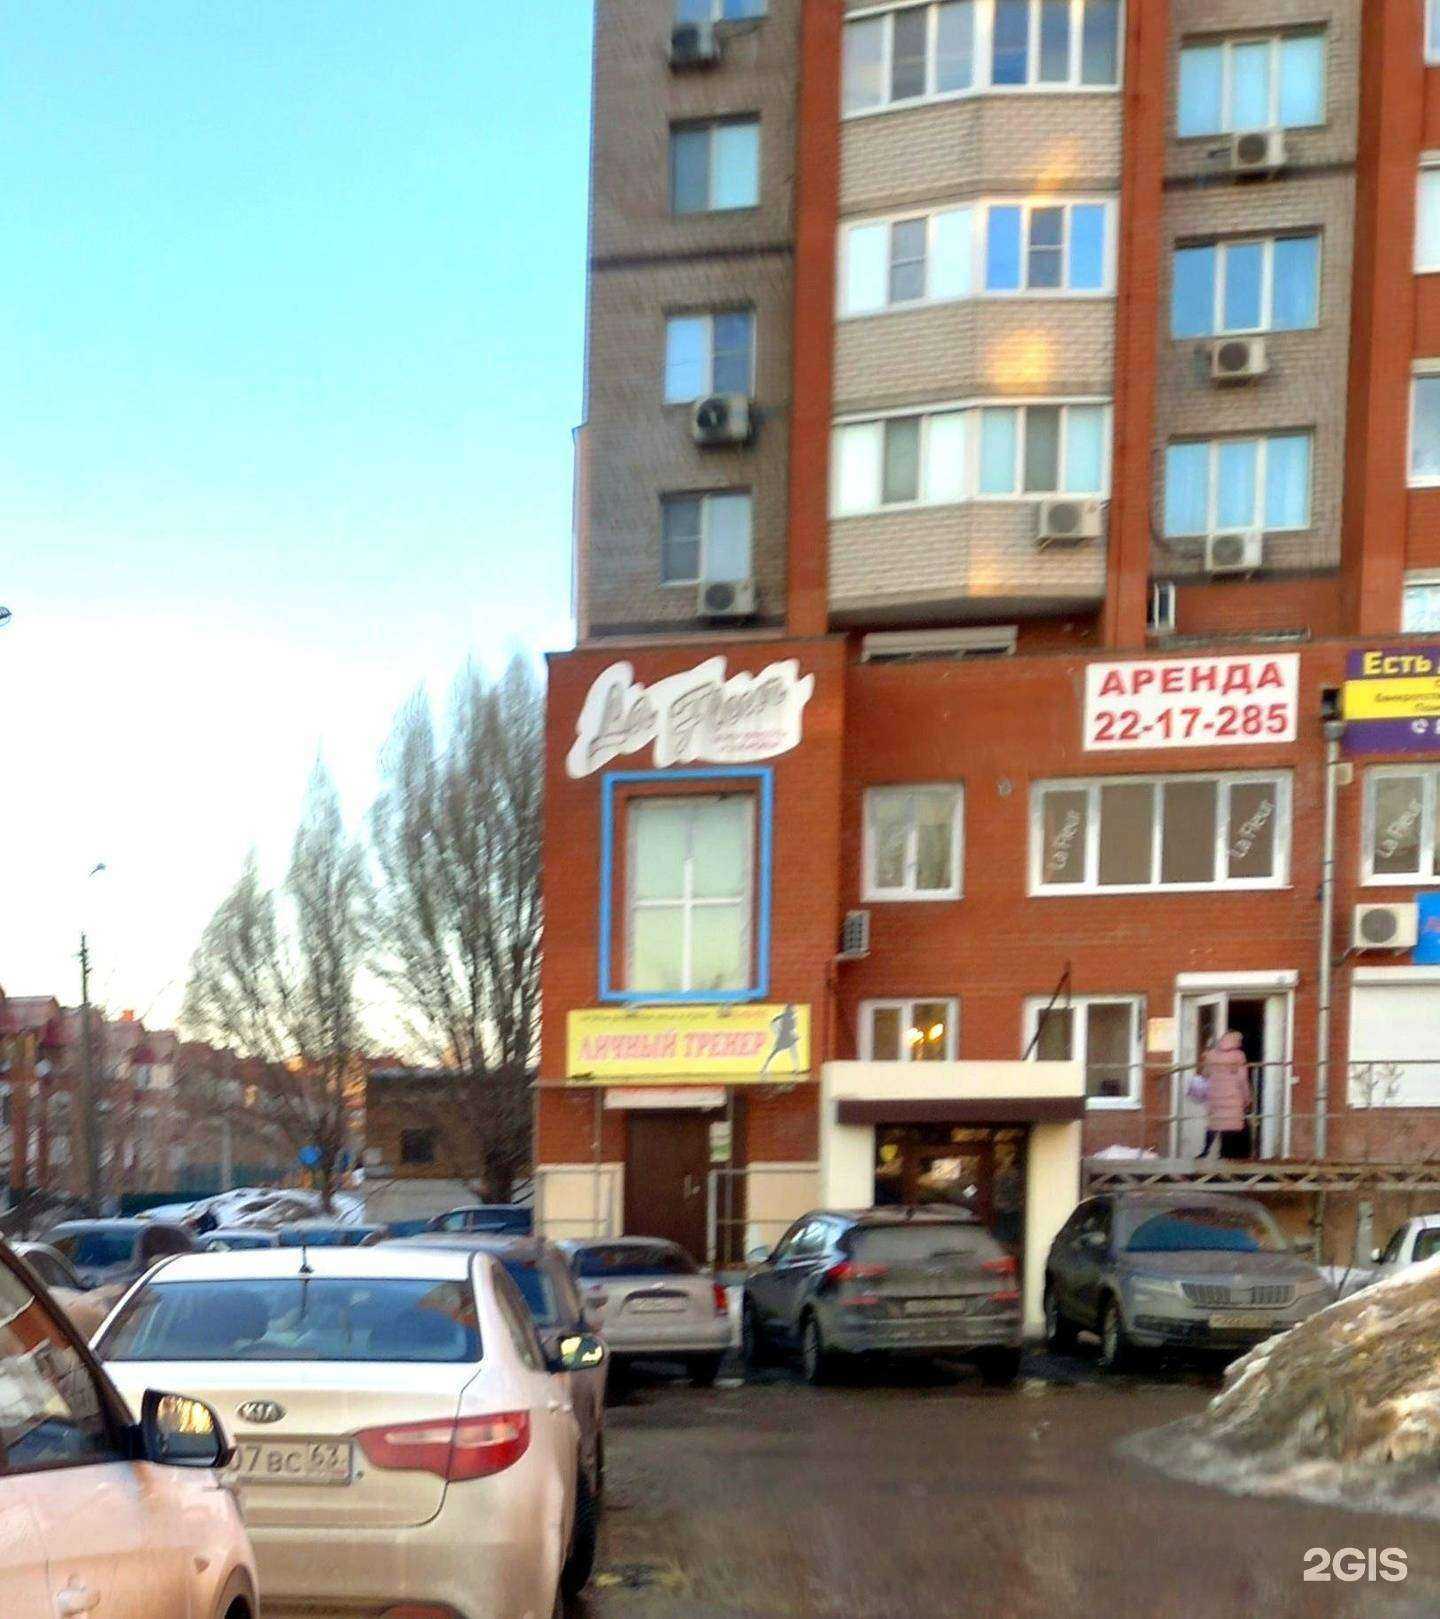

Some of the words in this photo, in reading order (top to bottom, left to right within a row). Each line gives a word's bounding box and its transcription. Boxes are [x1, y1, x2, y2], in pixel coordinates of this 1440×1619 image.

[1099, 662, 1284, 696] АРЕНДА
[1363, 651, 1432, 675] Есть
[1093, 703, 1288, 741] 22-17-285
